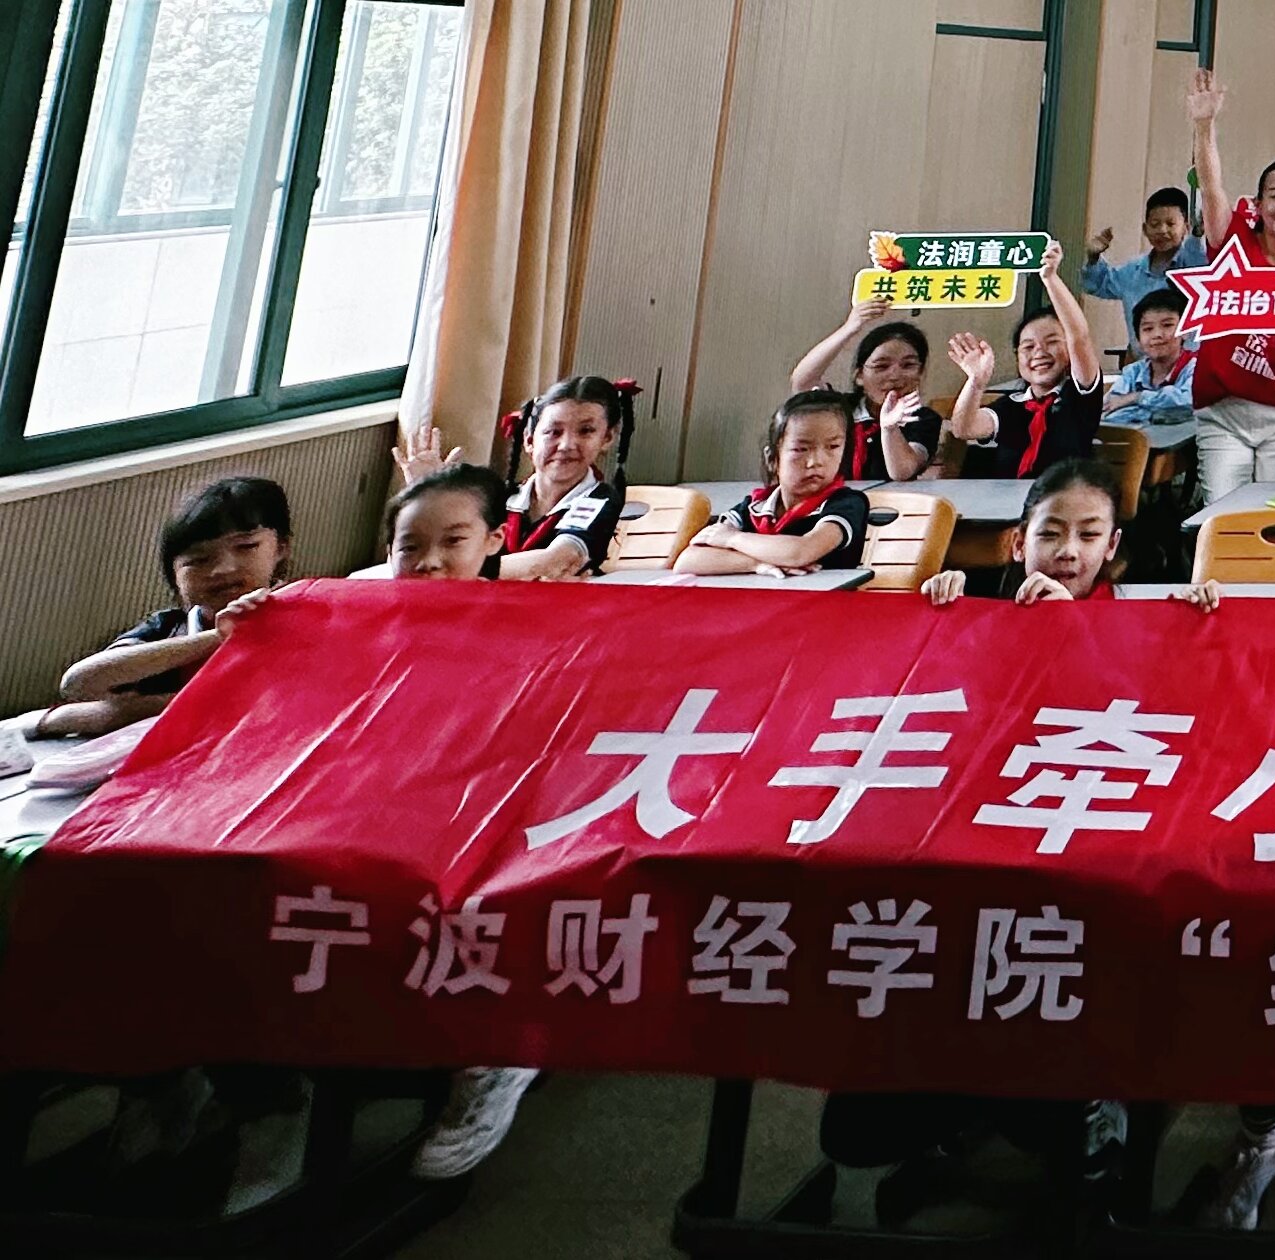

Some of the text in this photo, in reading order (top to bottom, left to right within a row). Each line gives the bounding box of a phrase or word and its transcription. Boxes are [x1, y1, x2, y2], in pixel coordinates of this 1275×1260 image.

[916, 239, 1034, 267] 法润童心
[871, 275, 1002, 303] 共筑未来
[268, 884, 1087, 1023] 宁波财经学院
